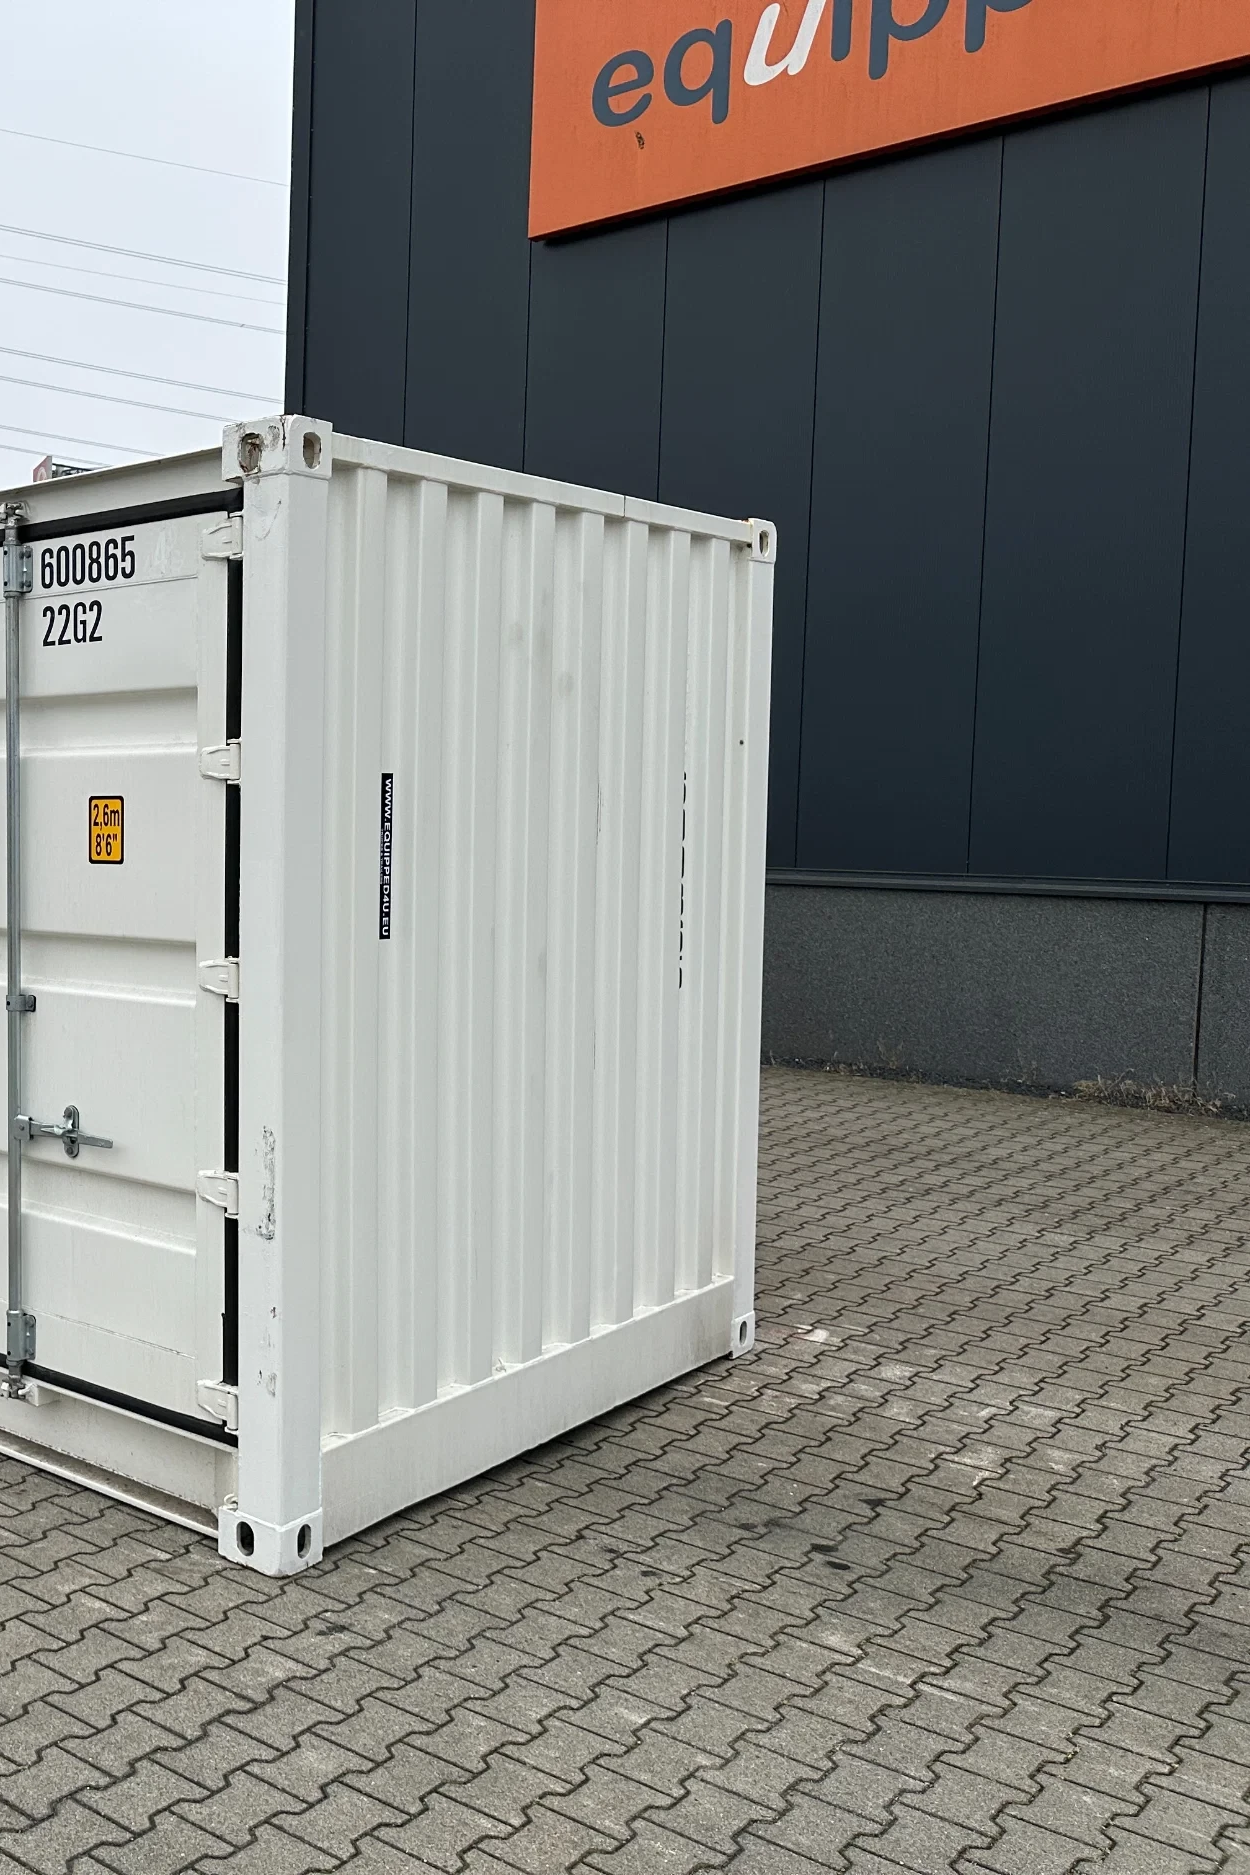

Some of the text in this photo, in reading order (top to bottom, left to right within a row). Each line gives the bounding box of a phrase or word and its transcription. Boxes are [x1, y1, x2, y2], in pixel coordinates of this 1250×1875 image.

[40, 534, 136, 590] 600865
[42, 599, 103, 647] 22G2
[93, 803, 120, 831] 2,6m
[95, 833, 118, 856] 8'6"
[382, 778, 392, 936] WWW.EQUIPPED4U.EU
